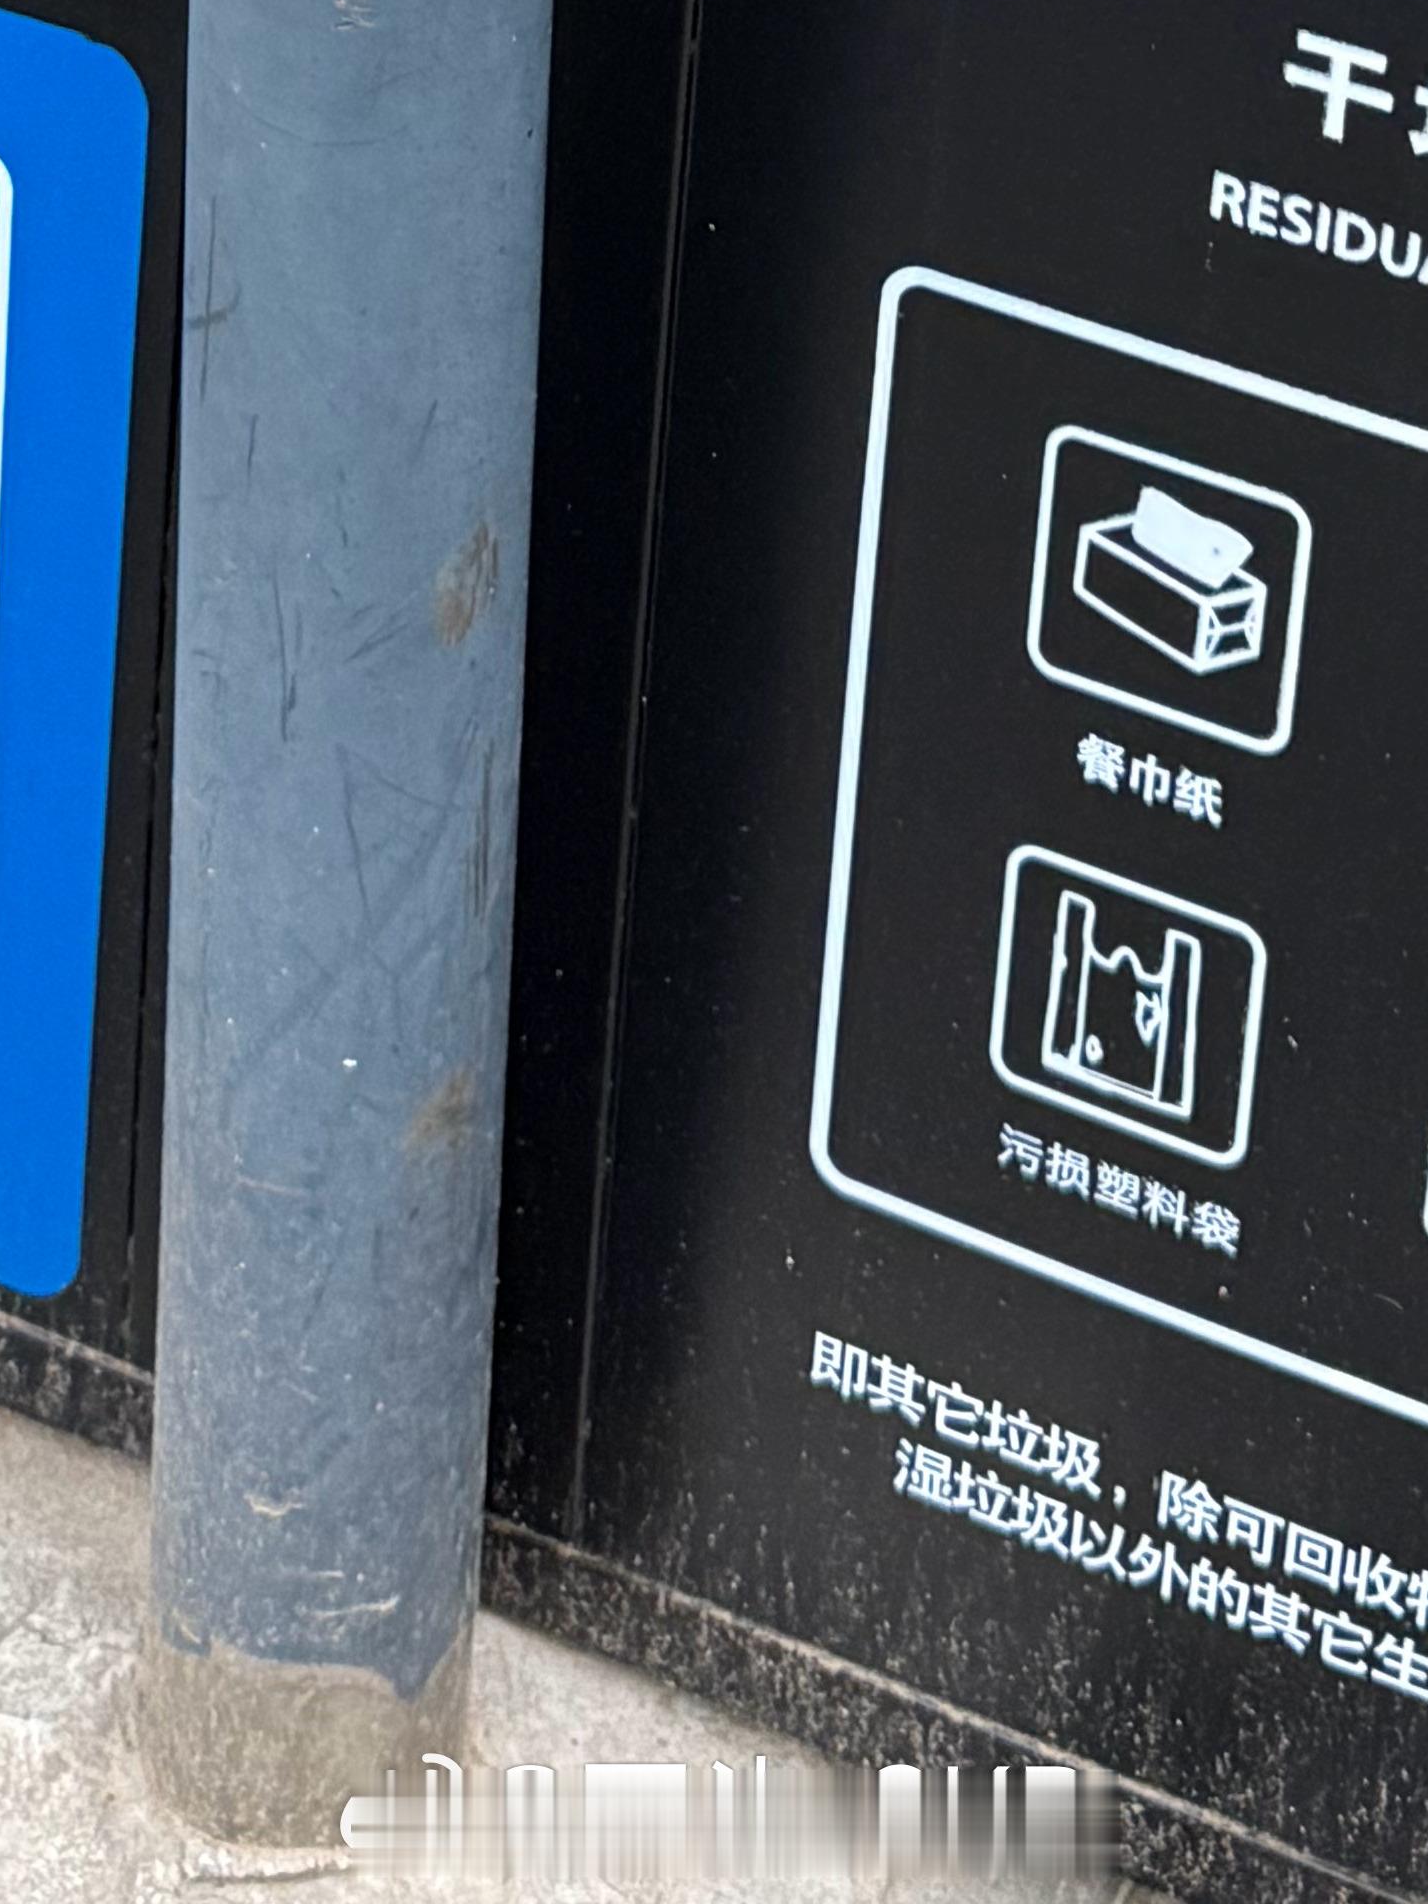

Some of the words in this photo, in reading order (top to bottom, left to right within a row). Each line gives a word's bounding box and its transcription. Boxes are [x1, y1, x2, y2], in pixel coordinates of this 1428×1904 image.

[1075, 732, 1223, 828] 餐巾纸
[996, 1121, 1243, 1257] 污损塑料袋
